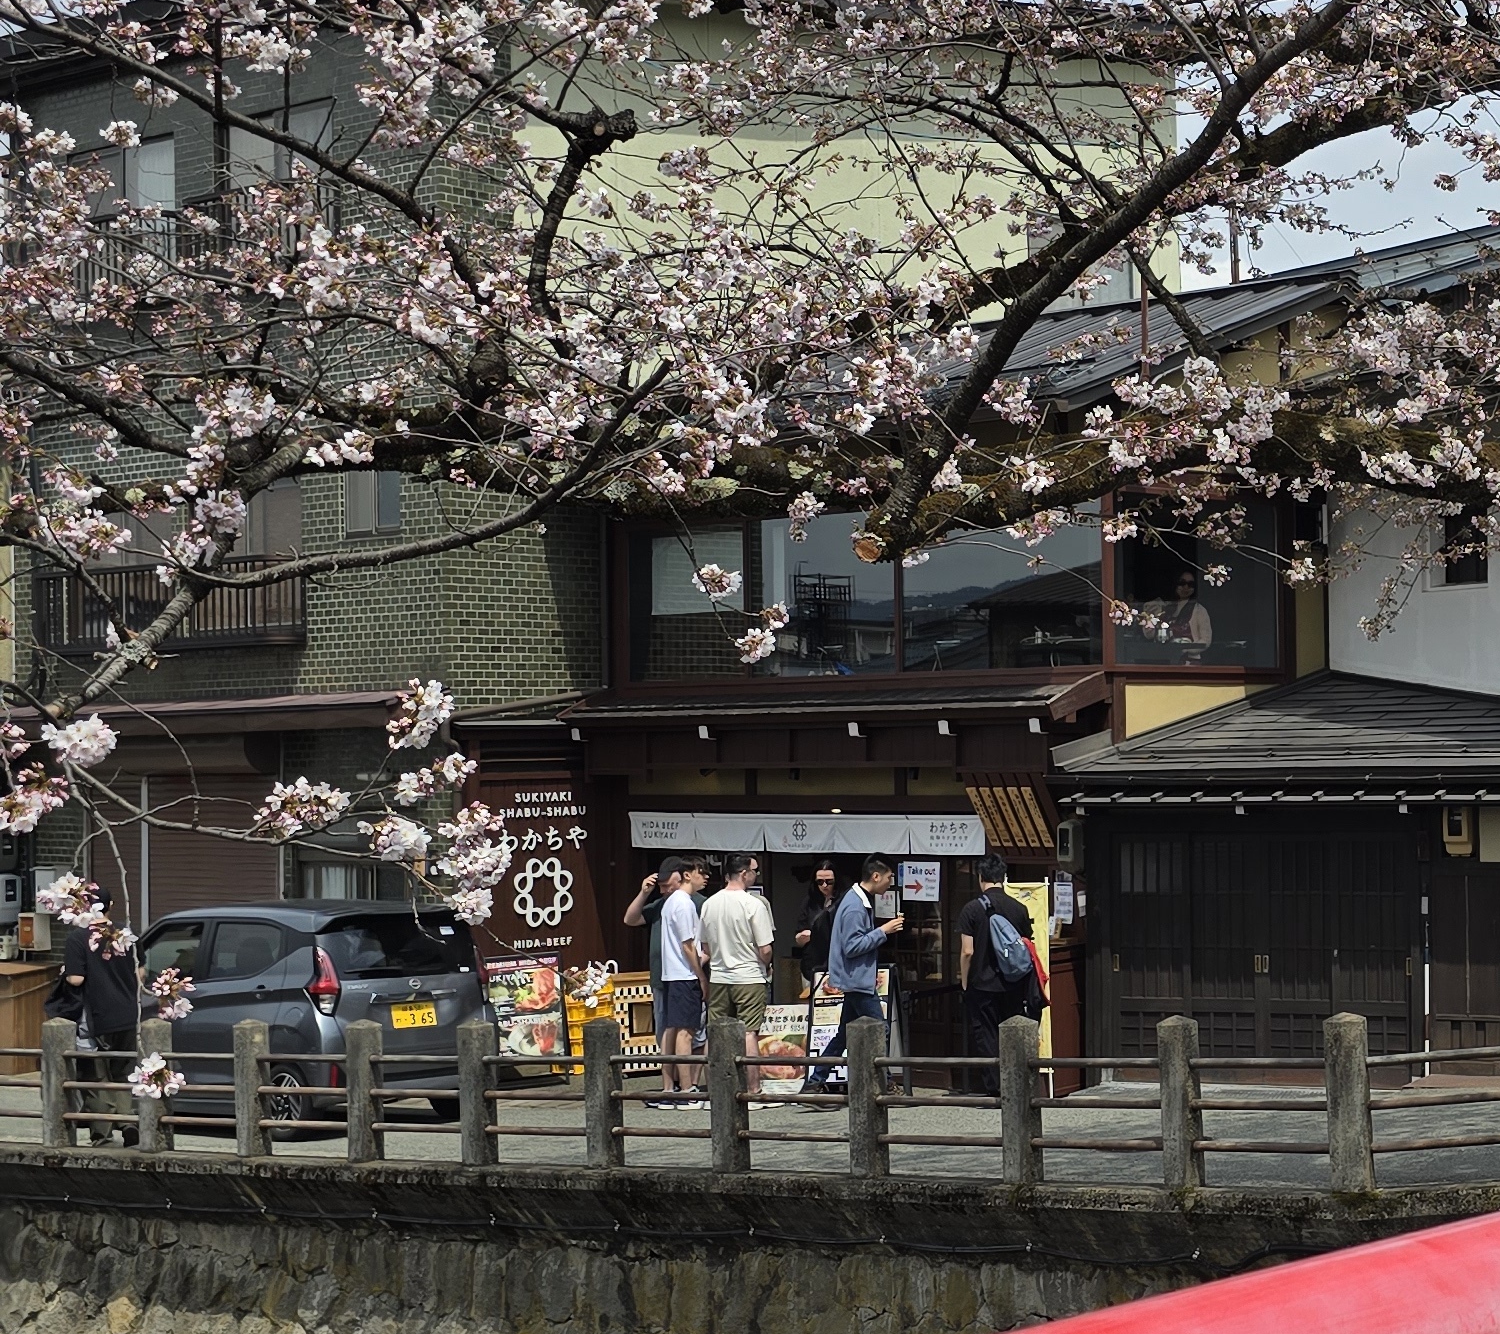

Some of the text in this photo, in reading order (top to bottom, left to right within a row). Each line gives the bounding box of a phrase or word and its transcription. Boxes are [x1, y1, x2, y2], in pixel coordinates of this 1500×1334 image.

[514, 791, 573, 804] SUKIYAKI
[499, 805, 588, 819] SHABU-SHABU
[641, 821, 680, 830] HIDA BEEF
[929, 821, 969, 835] わかちや
[498, 825, 588, 852] わかちや
[643, 830, 678, 840] SUKIYAKI
[513, 936, 573, 949] HIDA-BEEF
